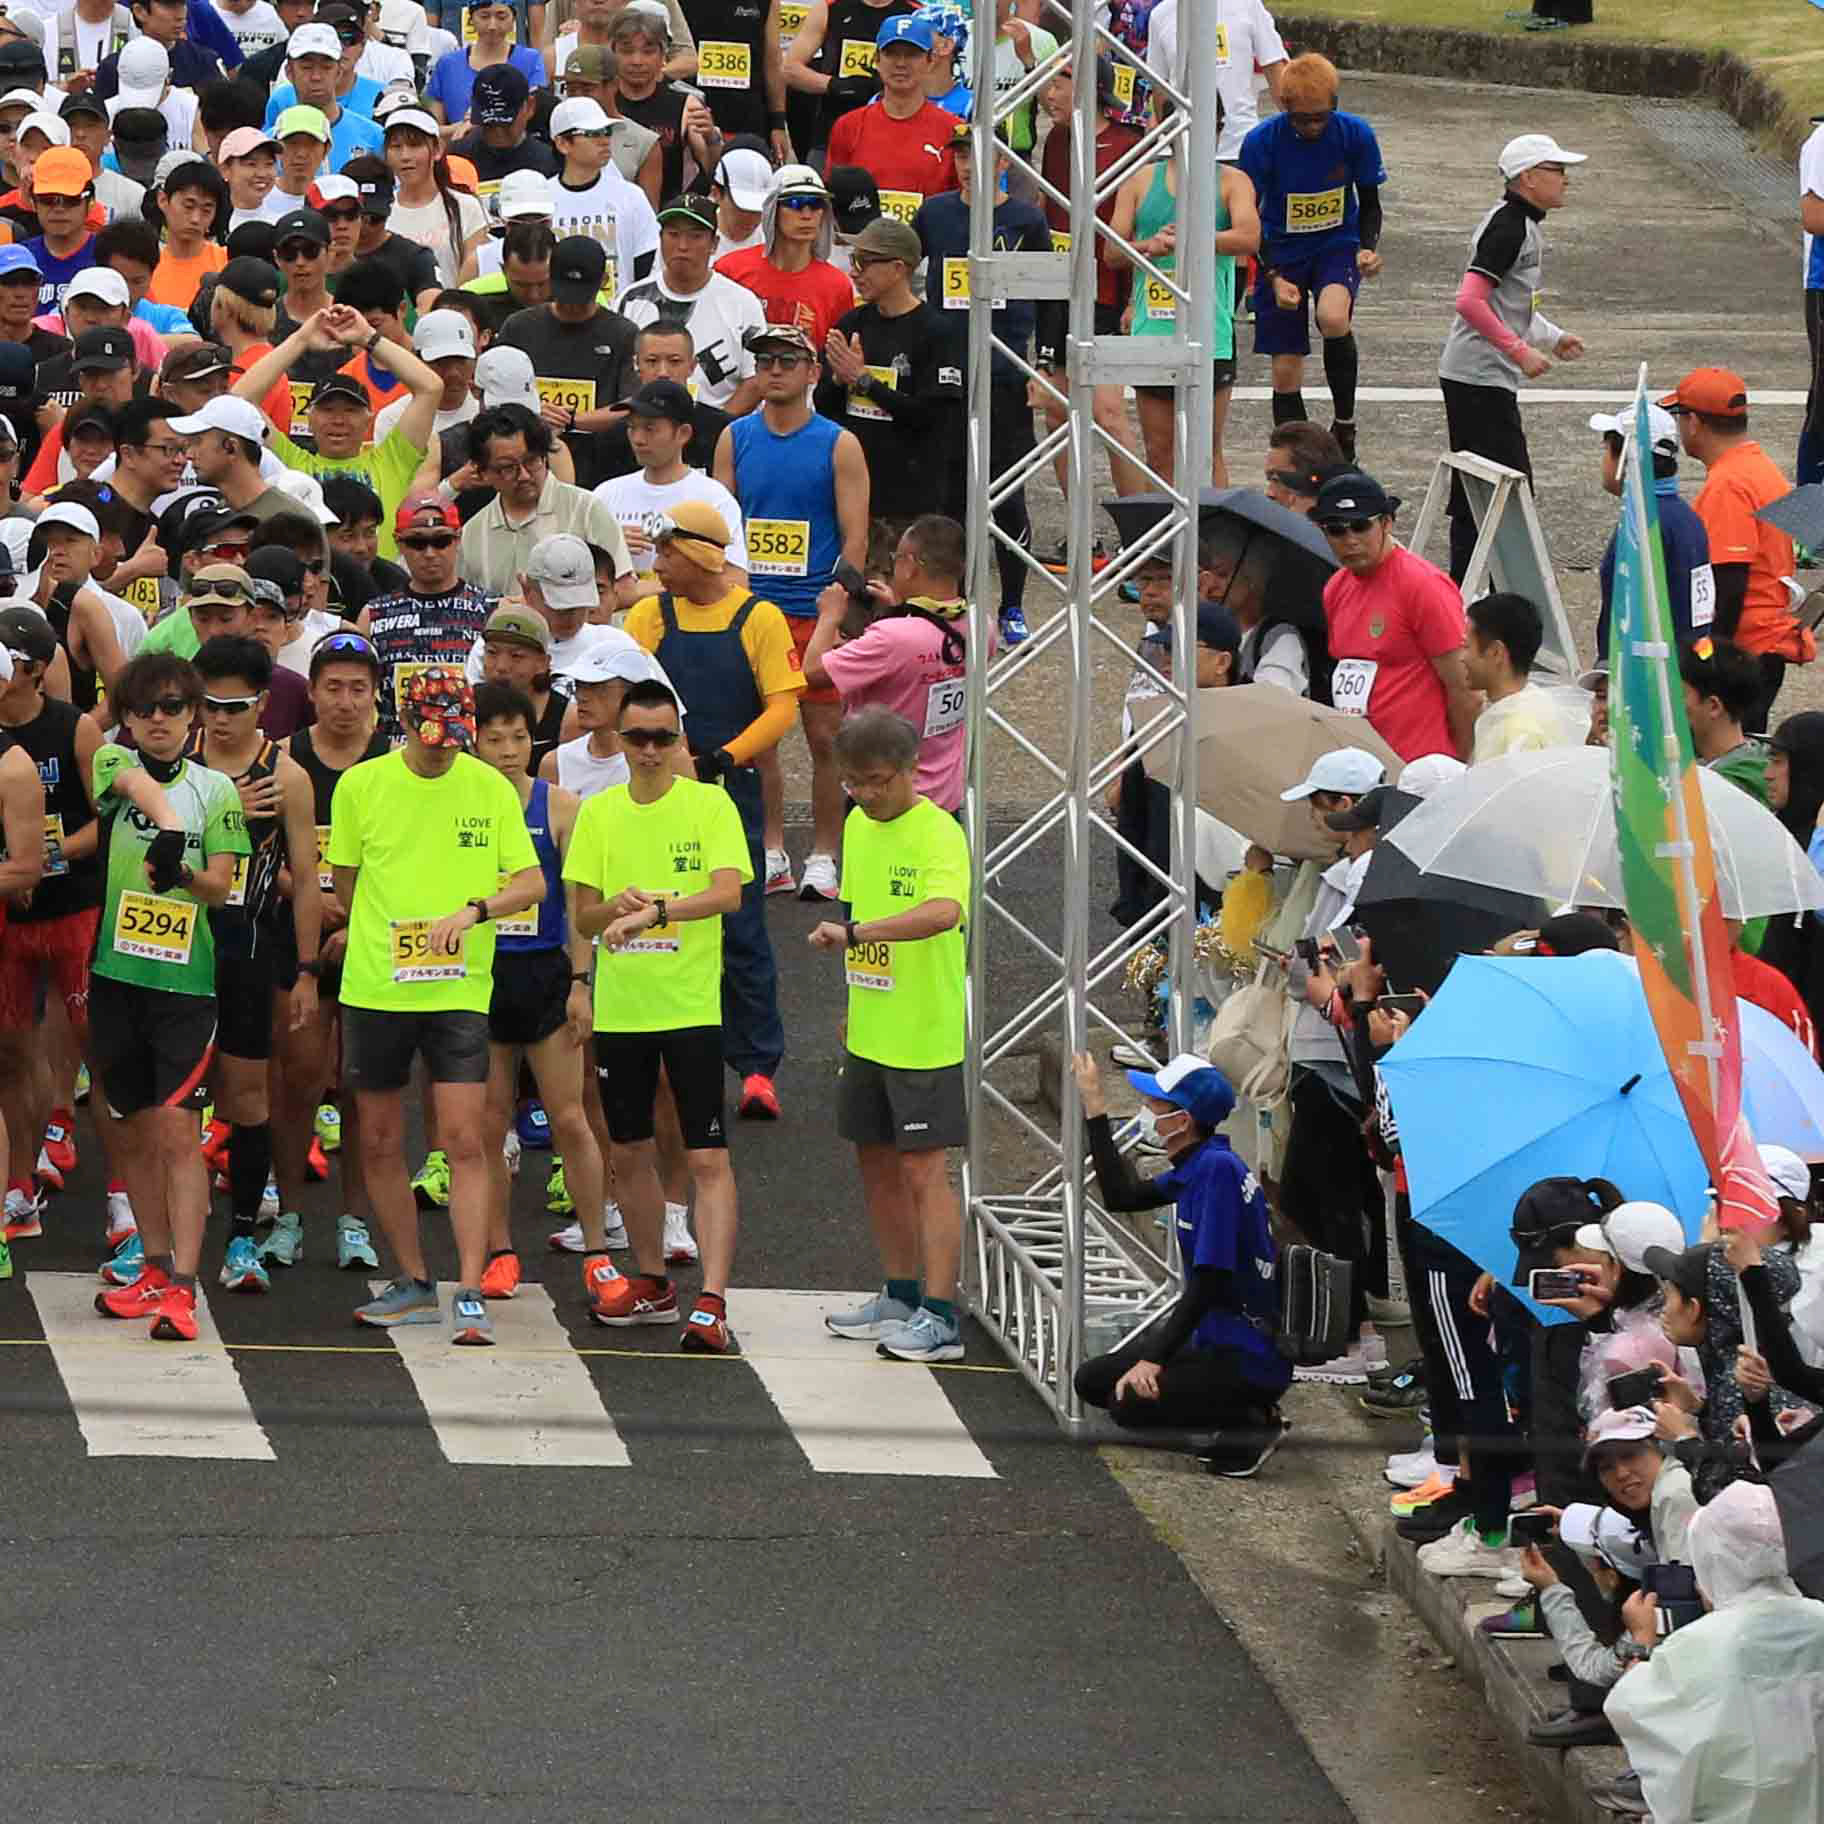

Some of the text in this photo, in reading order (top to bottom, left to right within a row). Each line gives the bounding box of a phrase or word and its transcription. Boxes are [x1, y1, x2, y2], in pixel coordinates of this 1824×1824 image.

[702, 52, 747, 71] 5386
[1291, 198, 1338, 218] 5862
[748, 531, 802, 556] 5582
[1335, 672, 1366, 697] 260
[461, 816, 491, 829] LOVE
[121, 906, 189, 940] 5294
[398, 931, 461, 960] 590
[848, 942, 890, 967] 5908
